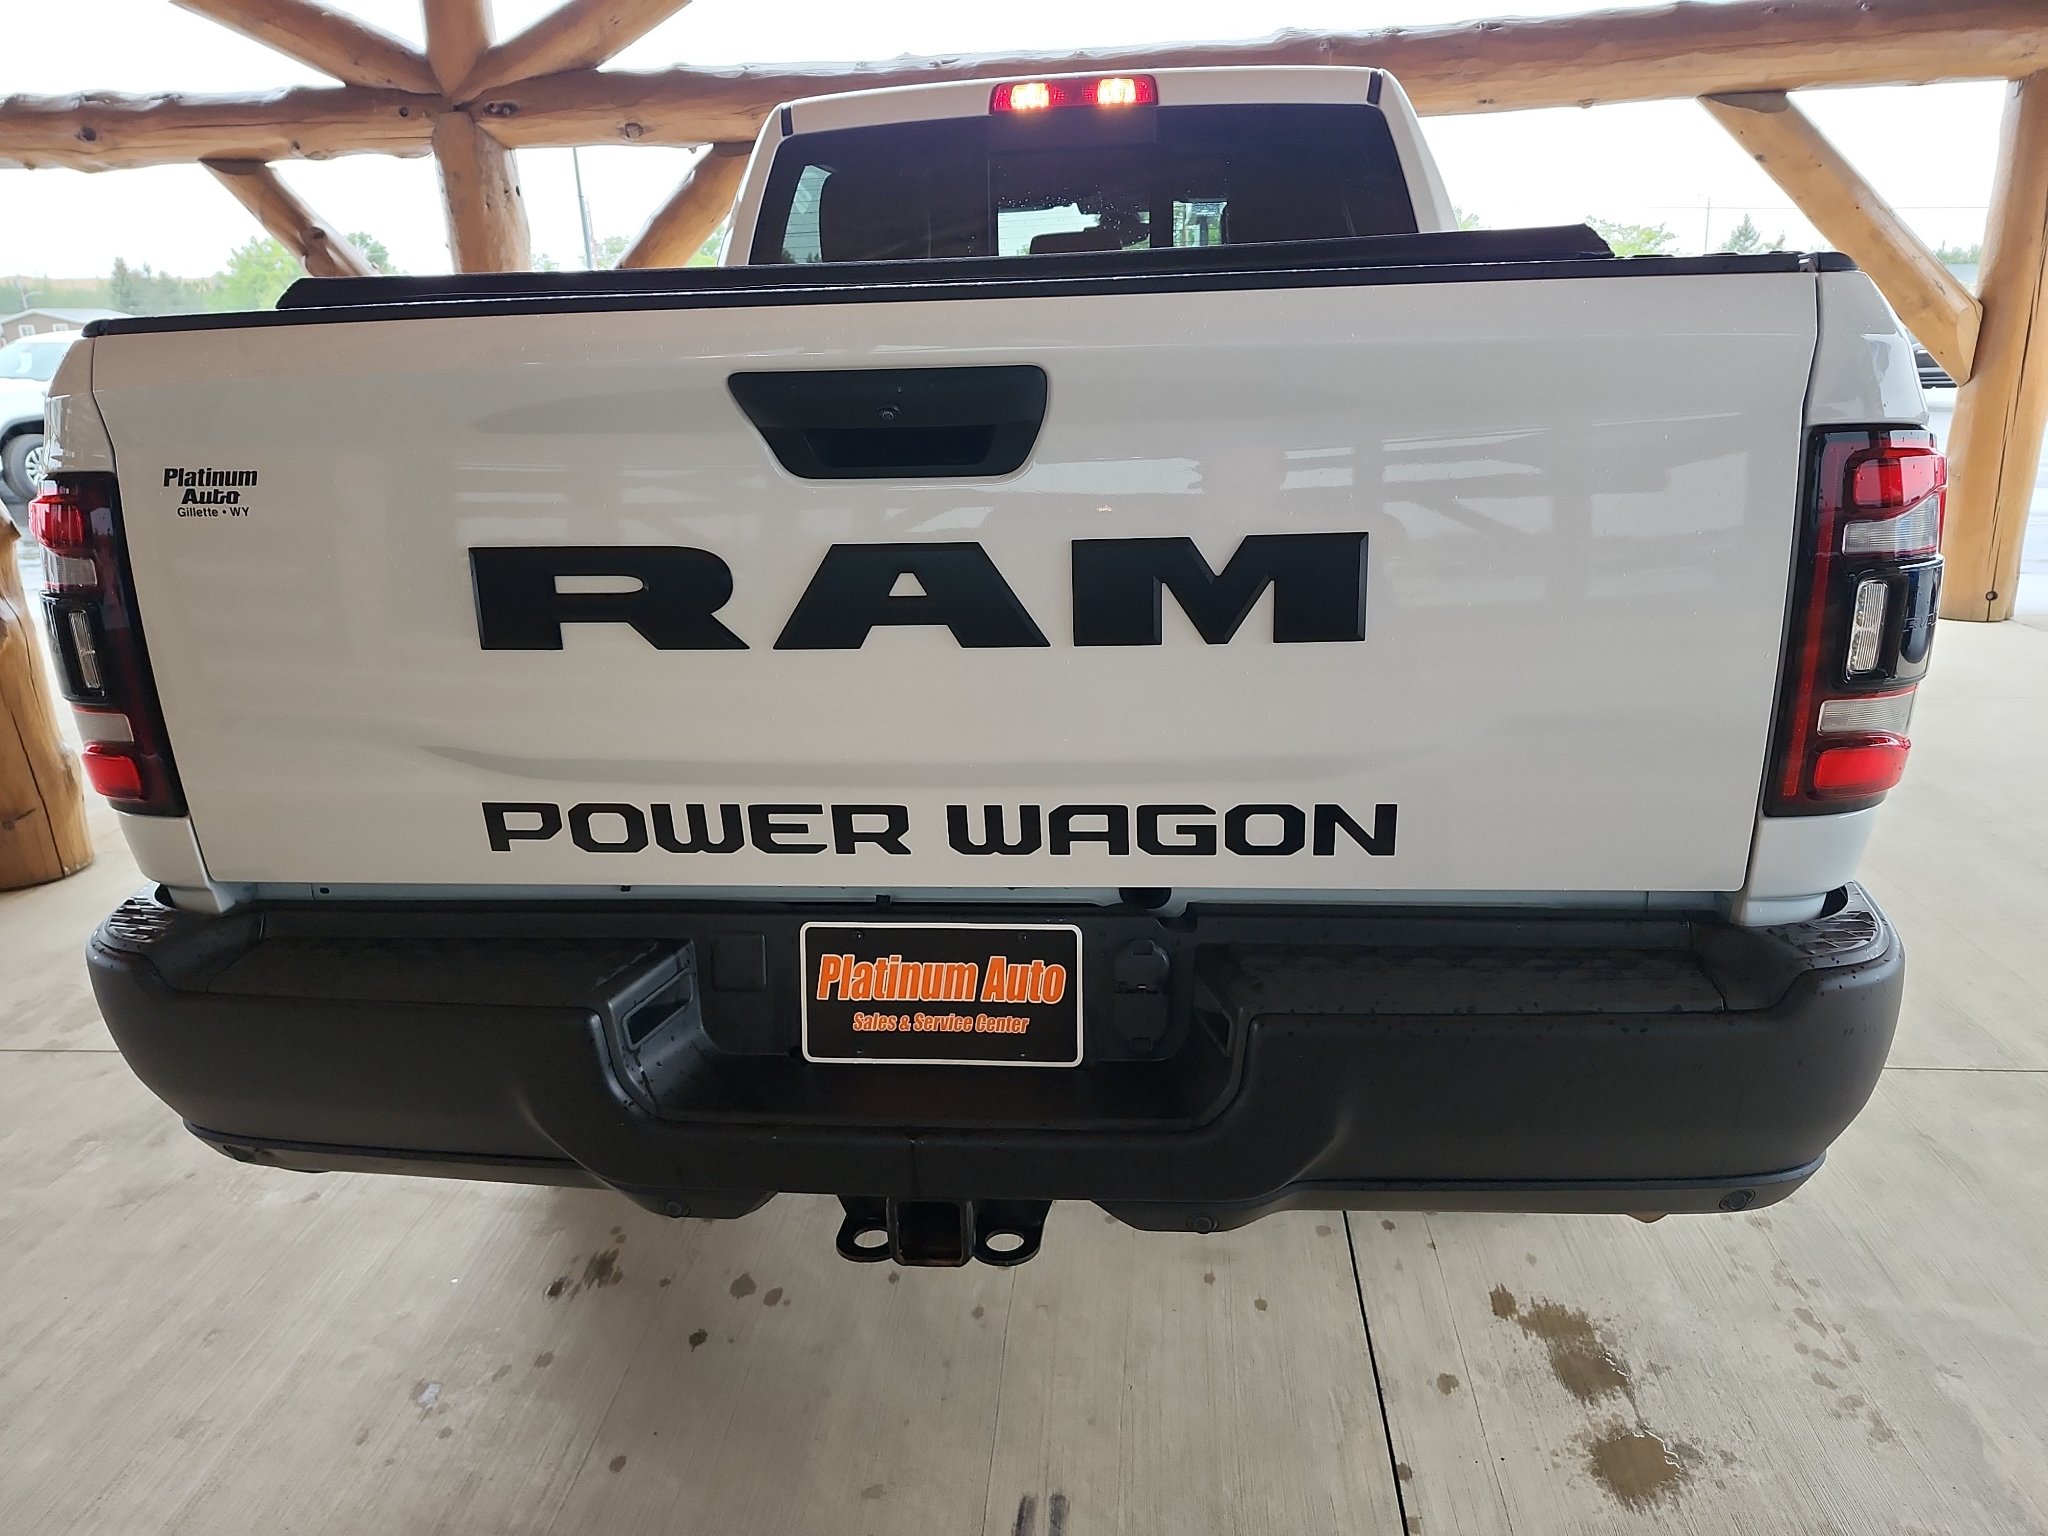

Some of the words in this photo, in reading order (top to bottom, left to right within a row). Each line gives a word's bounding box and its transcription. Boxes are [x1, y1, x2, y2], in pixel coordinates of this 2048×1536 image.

[164, 468, 258, 487] Platinum
[181, 488, 240, 504] Auto
[177, 507, 218, 517] Gillette
[229, 507, 249, 516] WY
[468, 531, 1368, 650] RAM
[482, 802, 911, 856] POWER
[946, 803, 1398, 856] WAGON
[817, 954, 979, 1001] Platinum
[981, 956, 1066, 1004] Auto
[852, 1011, 897, 1032] Sales
[899, 1014, 911, 1032] &
[912, 1012, 973, 1034] Service
[974, 1013, 1030, 1035] Center
